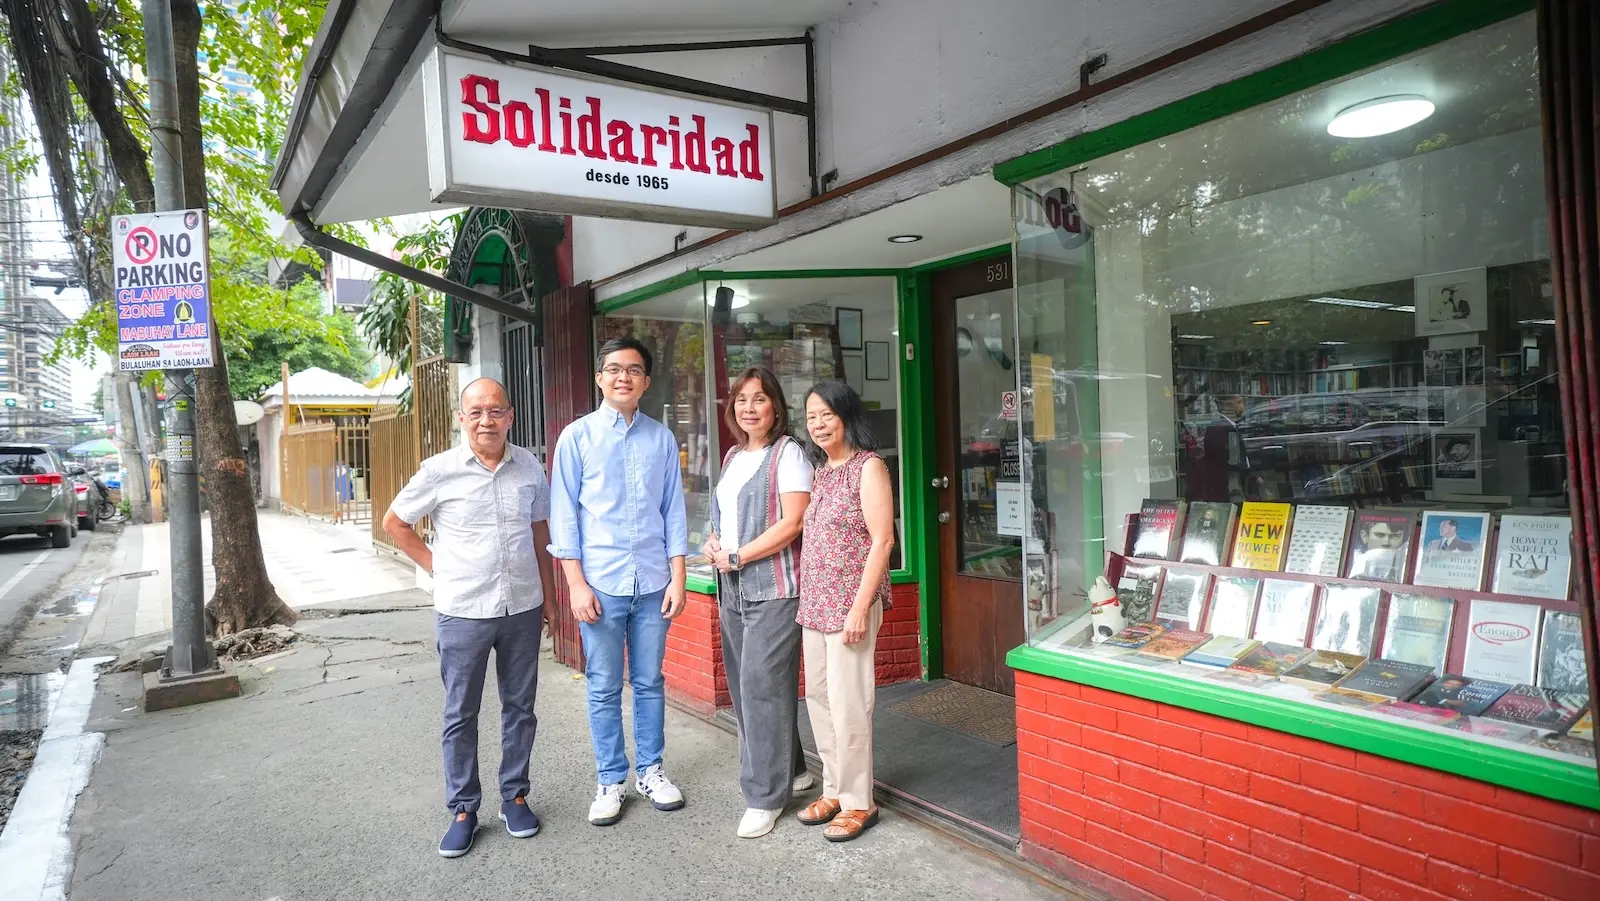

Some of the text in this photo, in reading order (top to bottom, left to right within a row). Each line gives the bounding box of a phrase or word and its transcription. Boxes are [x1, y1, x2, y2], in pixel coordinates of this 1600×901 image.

[460, 73, 764, 181] Solidaridad
[585, 168, 669, 190] desde 1965
[160, 232, 191, 259] NO
[117, 261, 203, 288] PARKING
[987, 262, 1008, 283] 531
[119, 286, 204, 303] CLAMPING
[119, 303, 165, 319] ZONE
[120, 323, 207, 341] MABUHAY LANE
[122, 350, 159, 359] LAON LAAN
[120, 357, 210, 370] BULALUHAN SA LAON-LAAN
[1240, 523, 1284, 540] NEW
[1512, 521, 1529, 529] KEN
[1511, 536, 1558, 546] HOW TO
[1238, 542, 1280, 554] POWER
[1510, 544, 1557, 554] SMELL A
[1430, 563, 1477, 571] COSMOPOLITAN
[1450, 557, 1478, 565] HITLER'S
[1508, 553, 1557, 570] RAT
[1479, 625, 1524, 640] Enough
[1364, 677, 1398, 686] MICHAEL
[1467, 683, 1498, 693] Matters
[1457, 694, 1484, 704] West
[1459, 689, 1492, 700] Cornel
